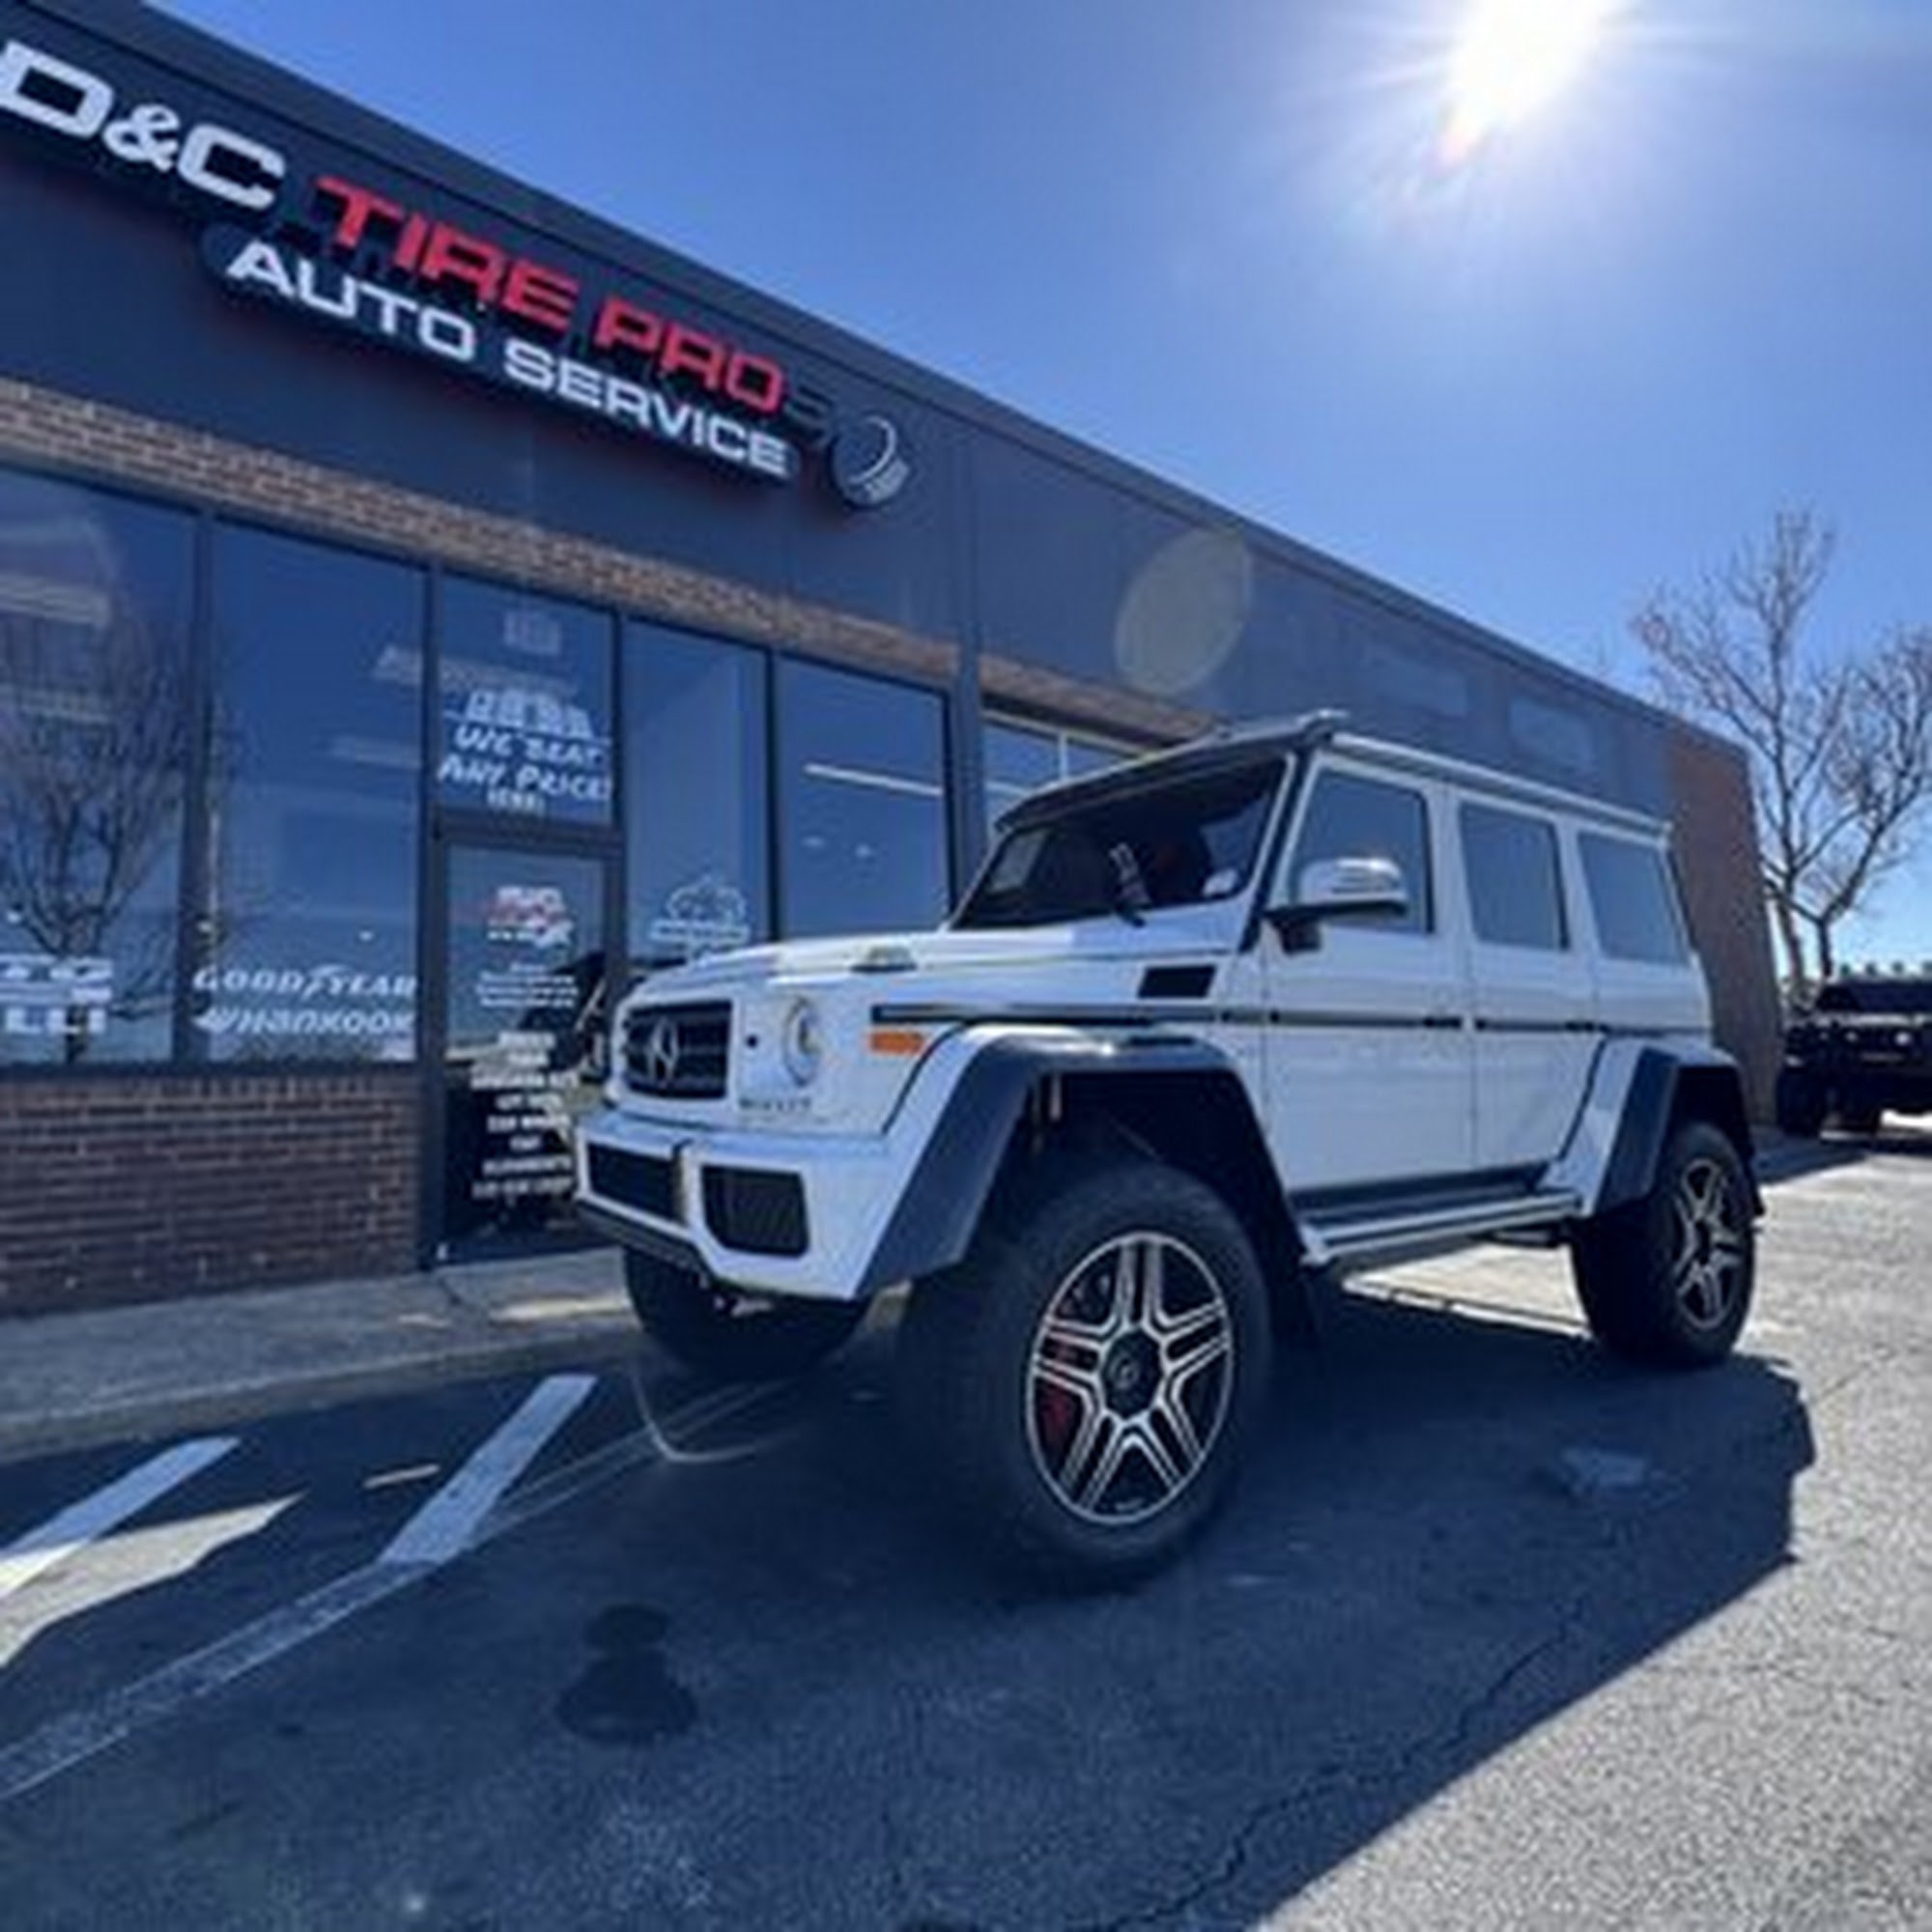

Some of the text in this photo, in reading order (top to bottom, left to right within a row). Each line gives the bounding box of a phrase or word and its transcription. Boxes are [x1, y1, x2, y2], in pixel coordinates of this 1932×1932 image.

[0, 40, 286, 210] D&C
[314, 174, 582, 331] TIRE
[225, 239, 789, 479] AUTO SERVICE
[438, 753, 506, 788] ANY
[192, 962, 418, 1002] GOODYEAR
[237, 1007, 417, 1036] HANKOOK
